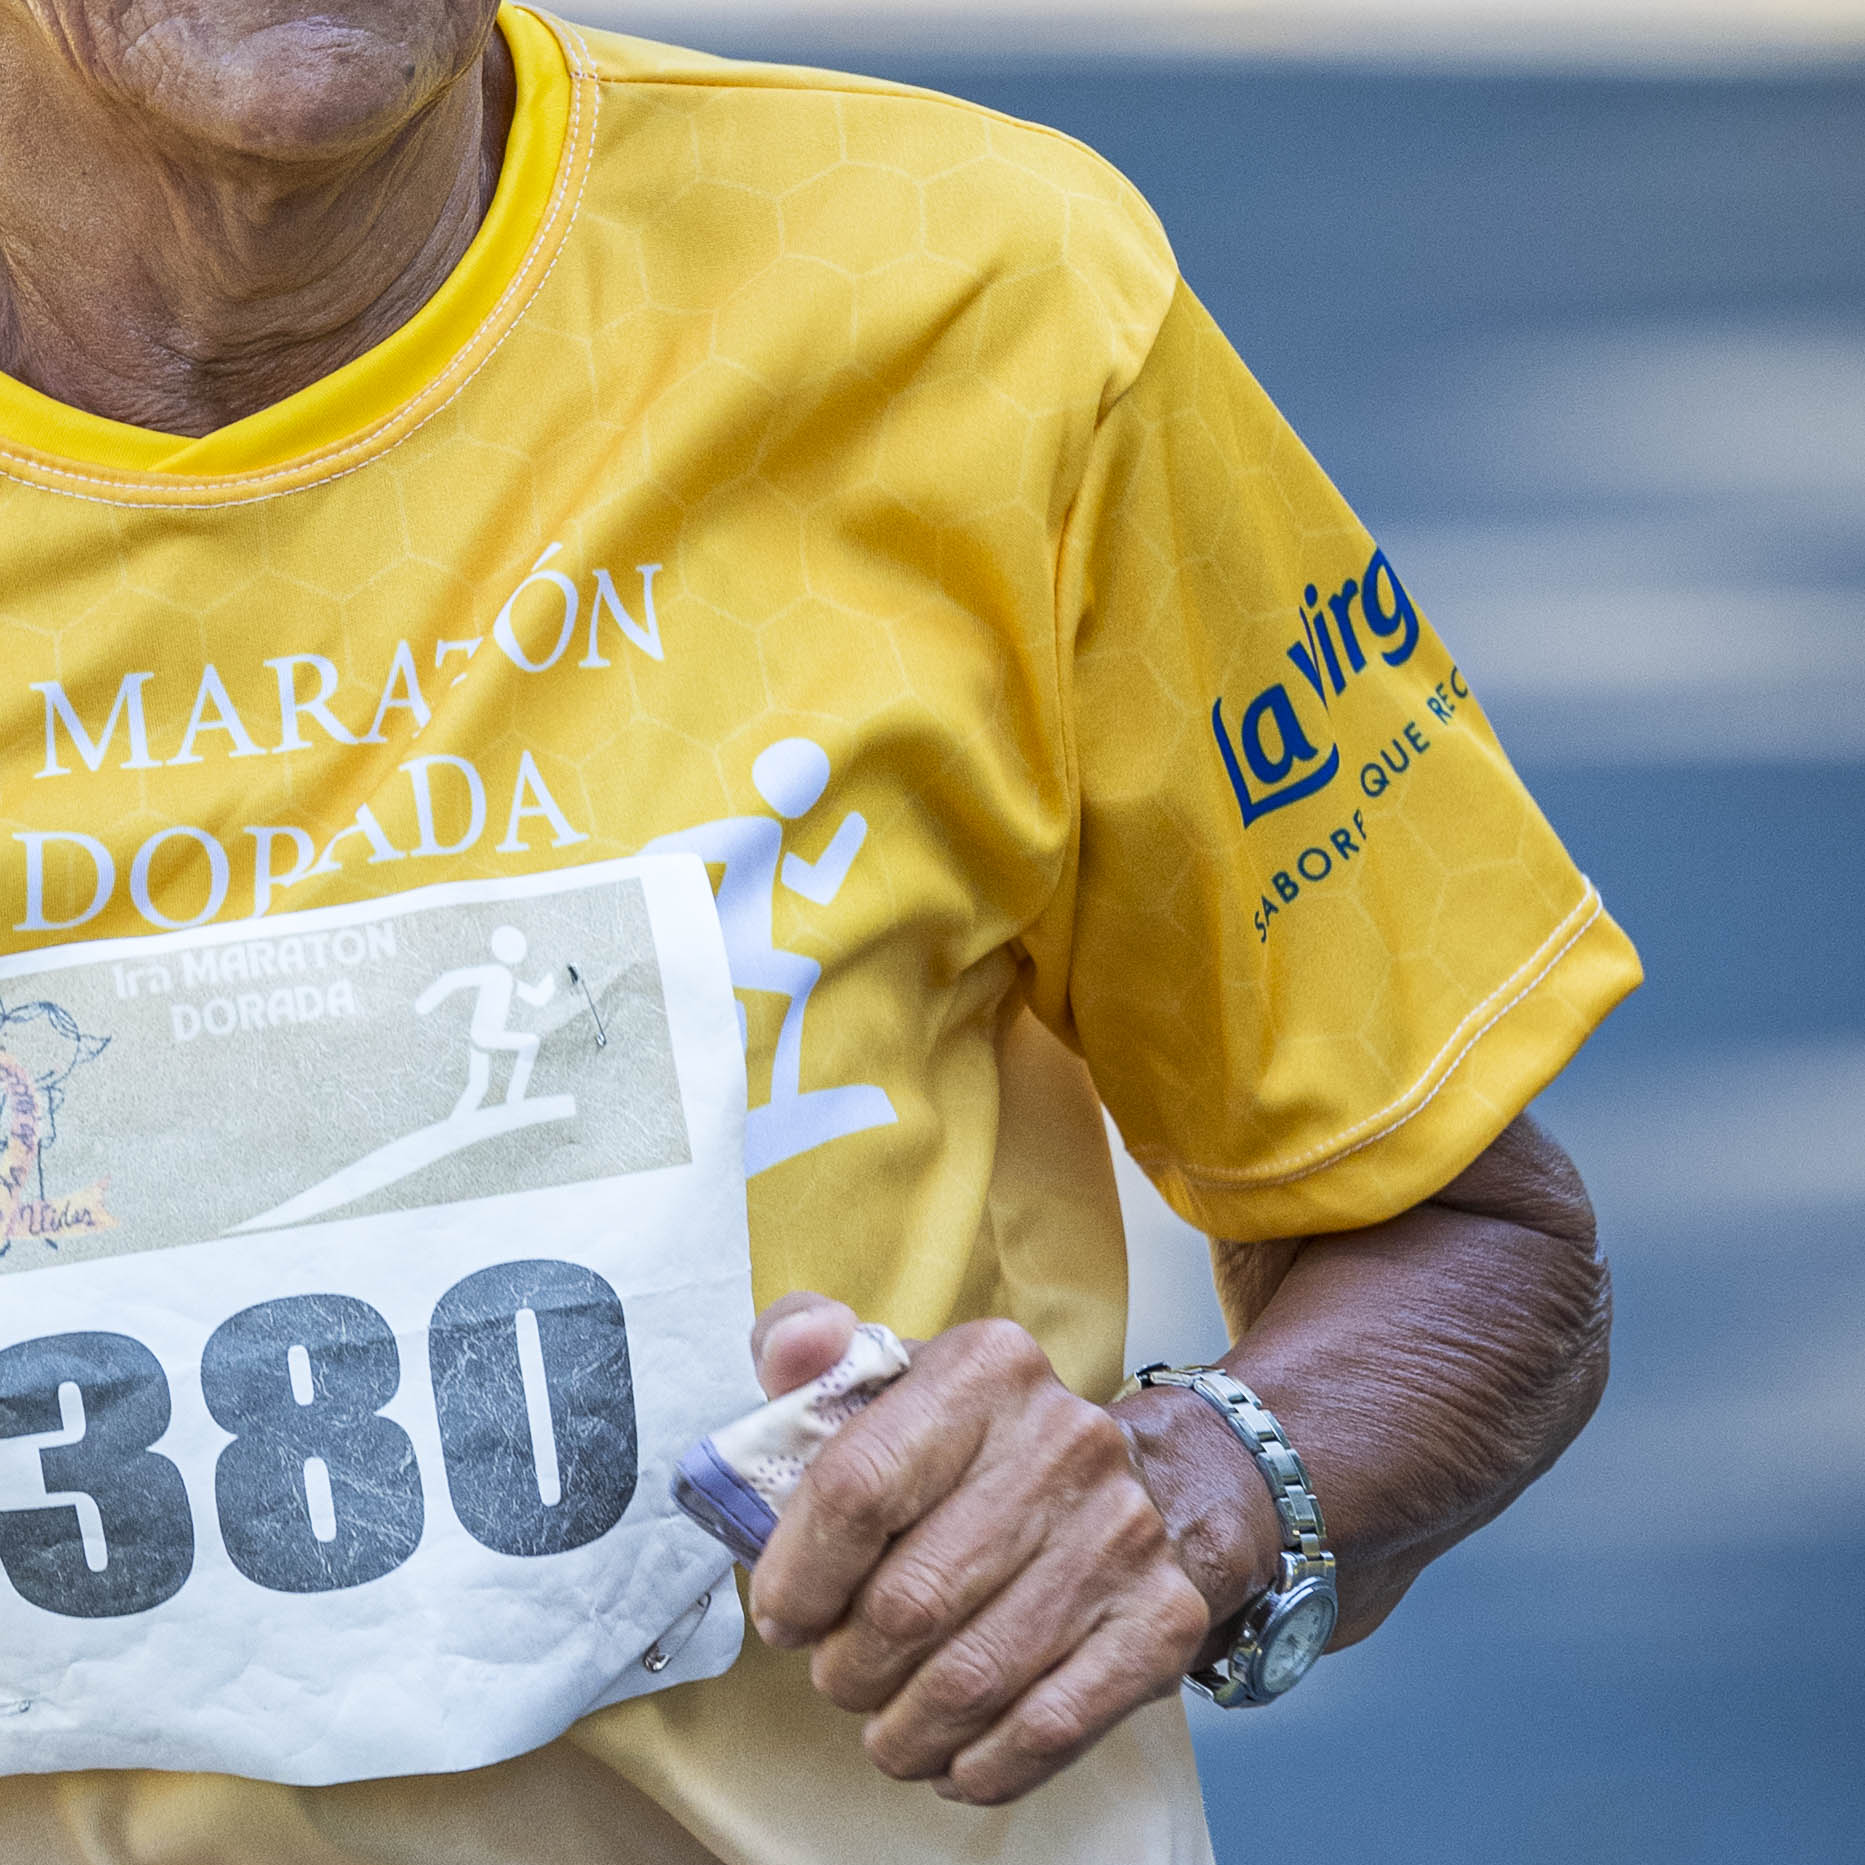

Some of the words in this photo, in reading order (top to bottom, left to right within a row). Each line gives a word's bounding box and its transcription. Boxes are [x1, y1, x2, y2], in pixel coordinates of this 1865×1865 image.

[1211, 683, 1340, 830] La
[1361, 721, 1431, 798] QUE
[12, 749, 589, 933] DORADA
[171, 978, 356, 1040] DORADA
